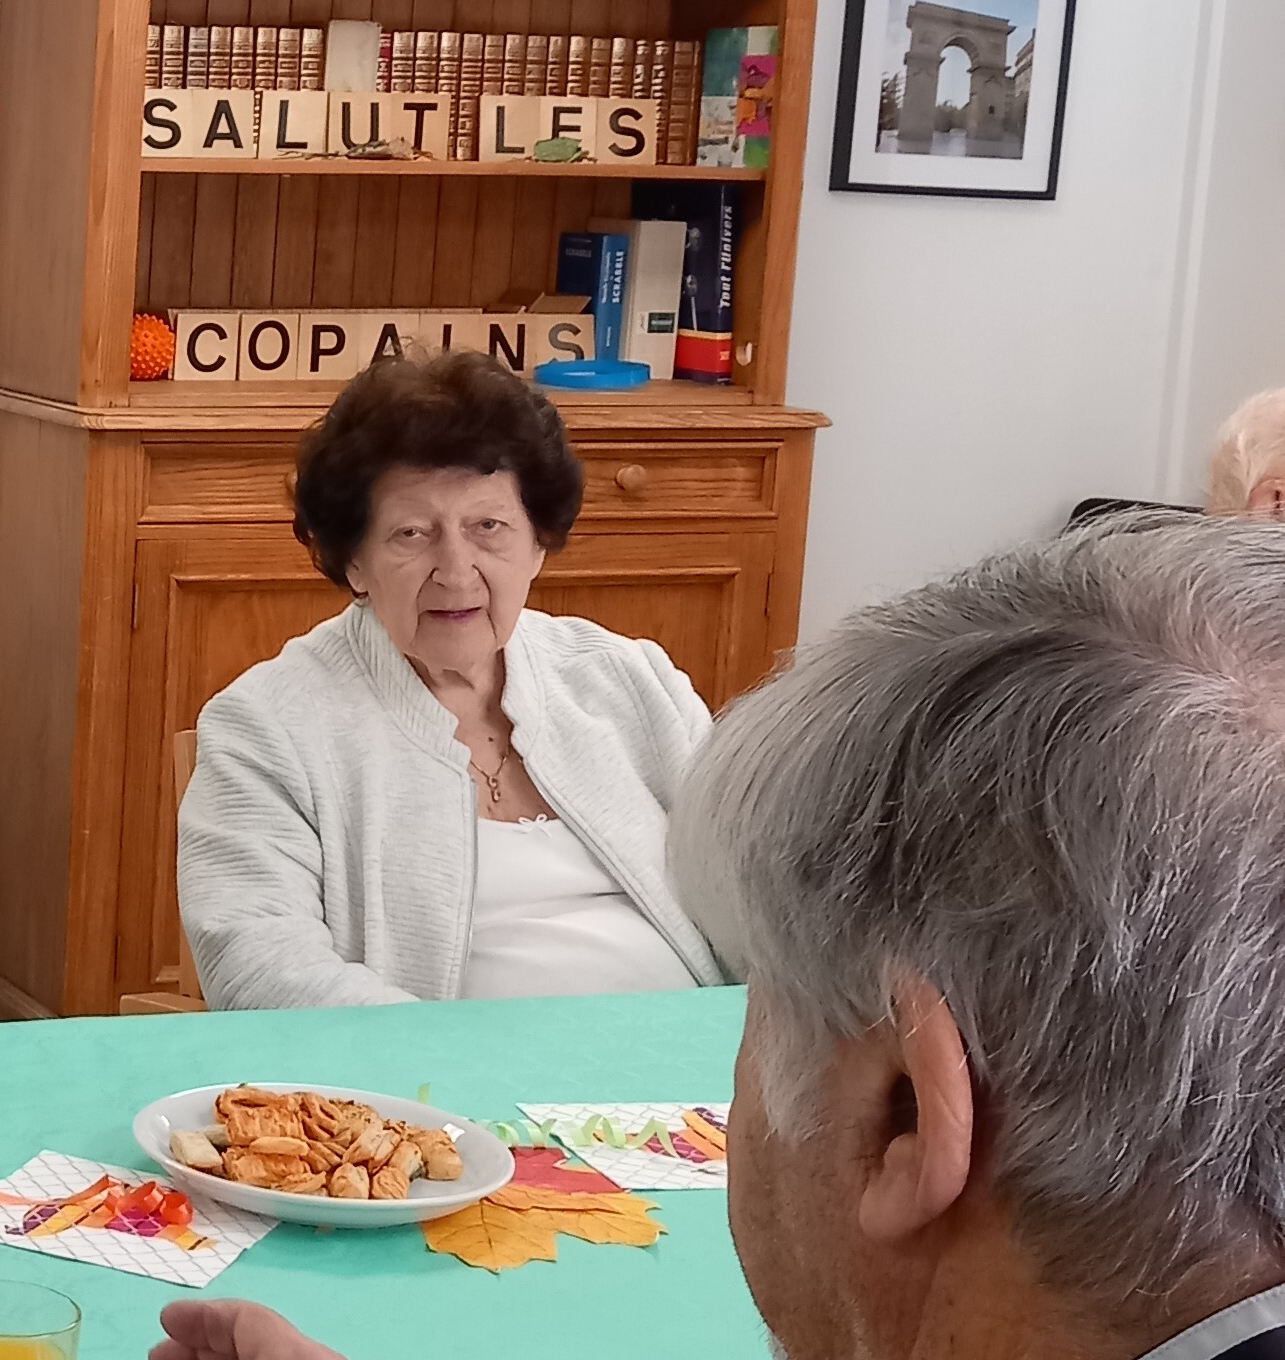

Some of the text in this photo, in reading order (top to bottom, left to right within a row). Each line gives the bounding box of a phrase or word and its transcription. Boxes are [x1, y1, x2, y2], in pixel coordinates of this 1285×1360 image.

[142, 97, 646, 158] SALUT LES
[612, 250, 625, 304] SCRABBLE
